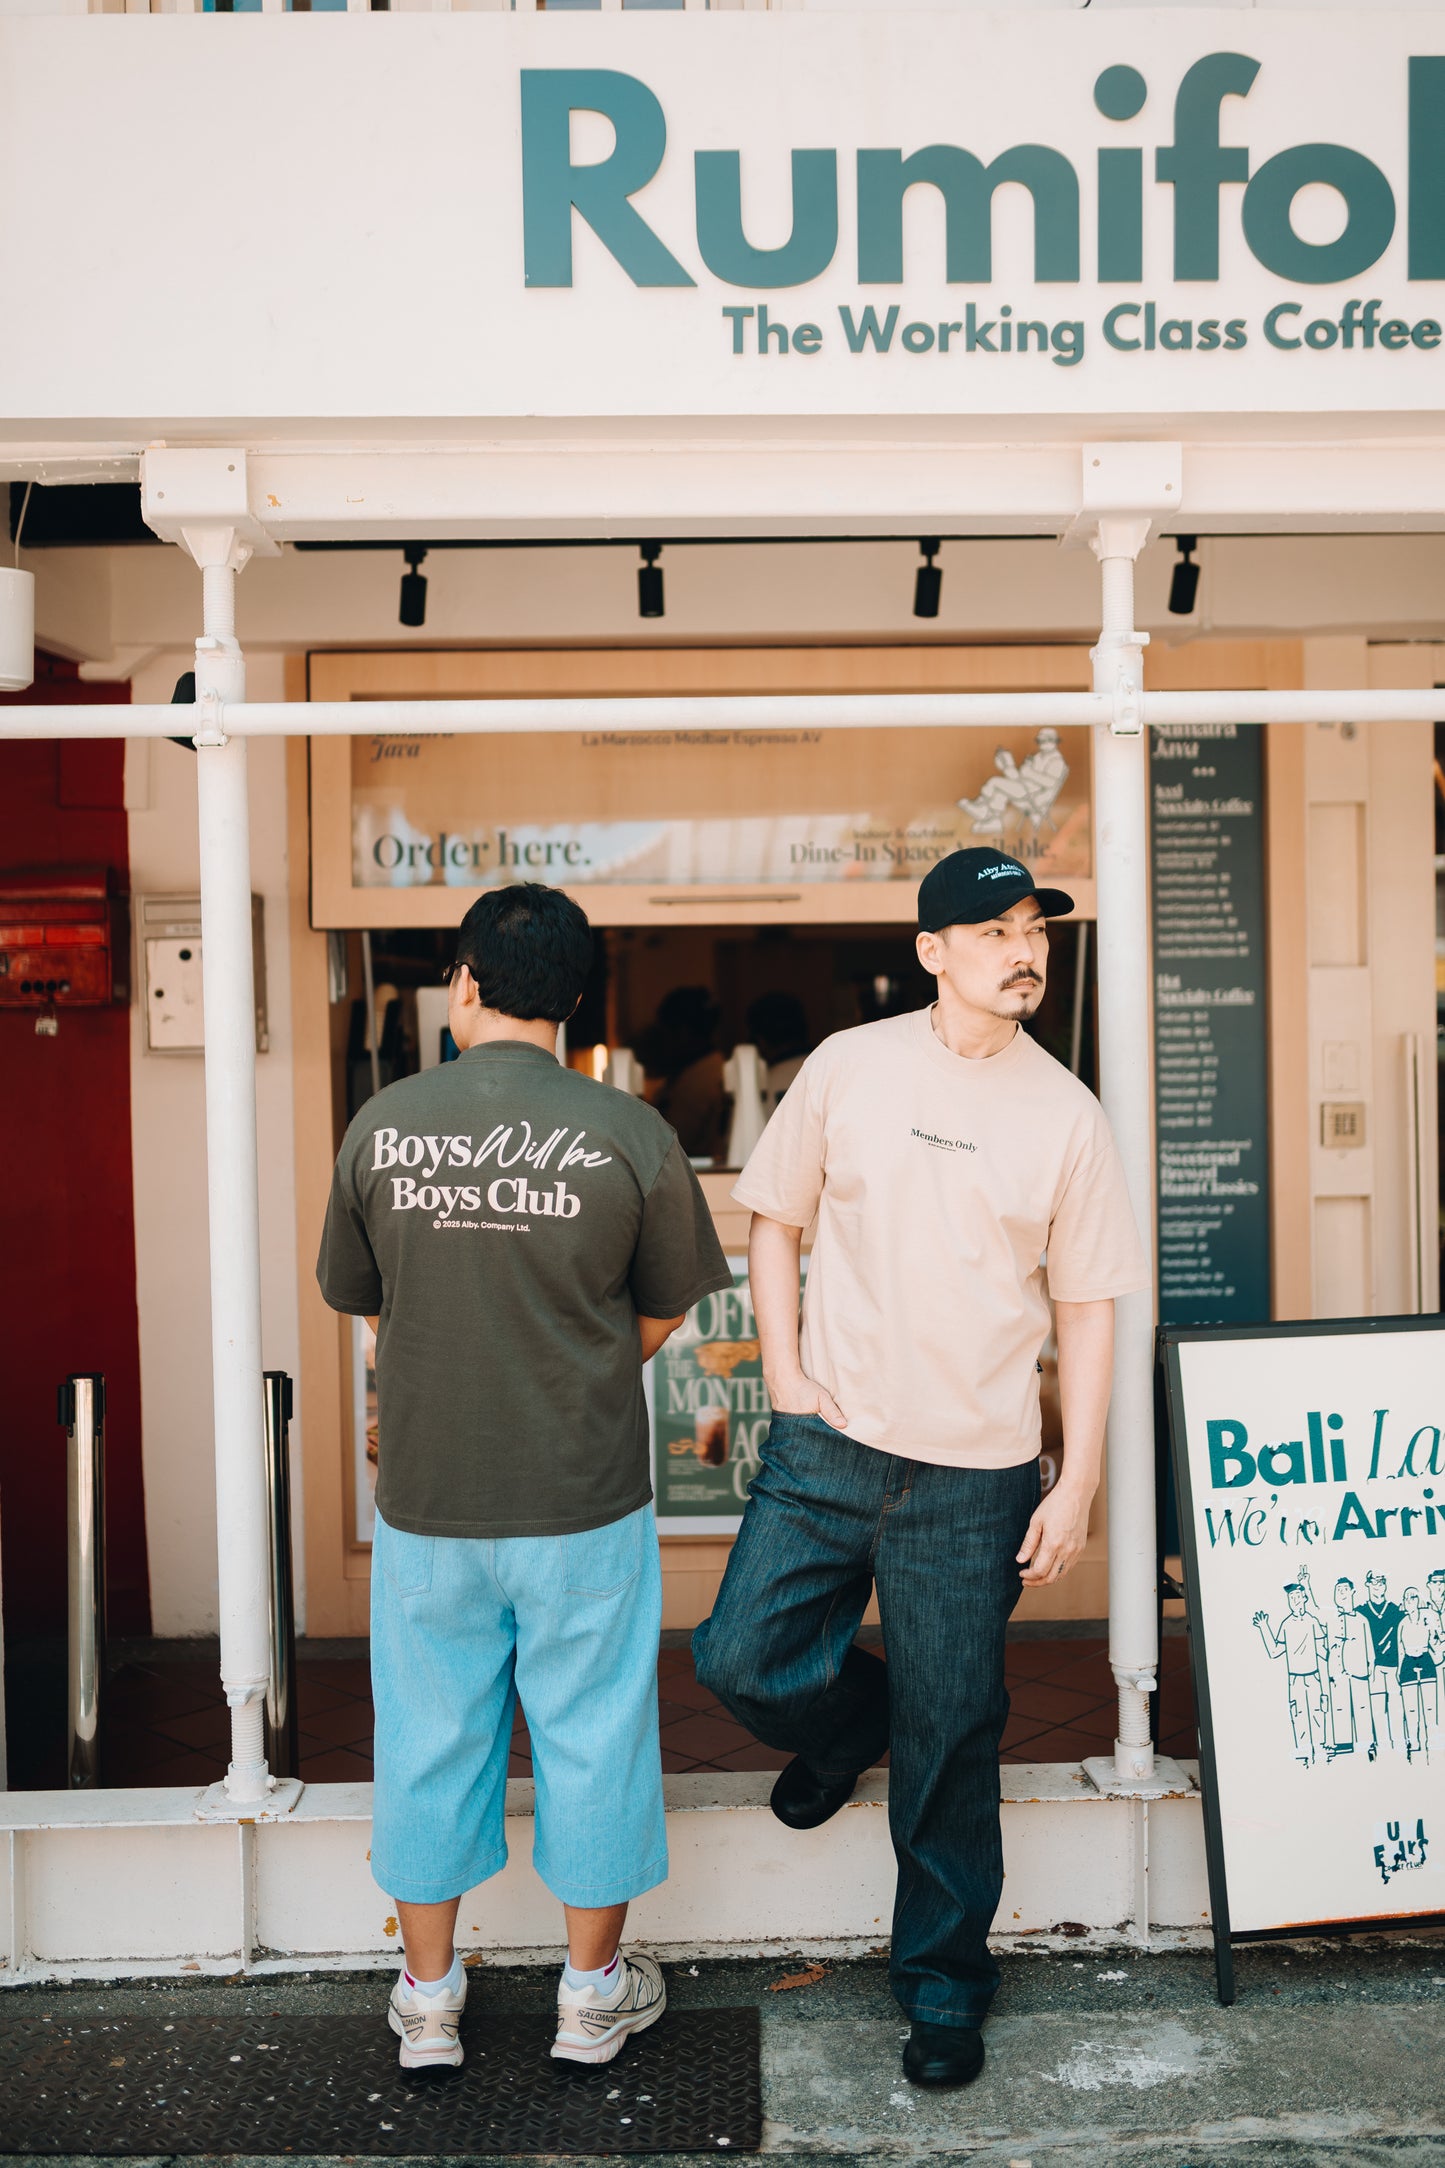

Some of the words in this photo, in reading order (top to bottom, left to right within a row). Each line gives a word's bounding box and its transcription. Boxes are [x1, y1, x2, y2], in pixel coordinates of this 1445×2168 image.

[723, 305, 823, 355] The
[838, 302, 1086, 367] Working
[1102, 301, 1248, 351] Class
[1263, 299, 1443, 351] Coffee
[372, 833, 489, 868] Order
[498, 831, 592, 867] here.
[371, 1127, 472, 1178] Boys
[472, 1121, 569, 1169] Will
[557, 1131, 613, 1172] be
[910, 1128, 954, 1147] Members
[955, 1140, 978, 1153] Only
[390, 1177, 481, 1219] Boys
[487, 1178, 581, 1218] Club
[480, 1221, 515, 1232] Company
[516, 1223, 531, 1232] Ltd.
[667, 1377, 772, 1414] MONTH
[1206, 1411, 1348, 1489] Bali
[577, 2010, 617, 2023] SALOMON
